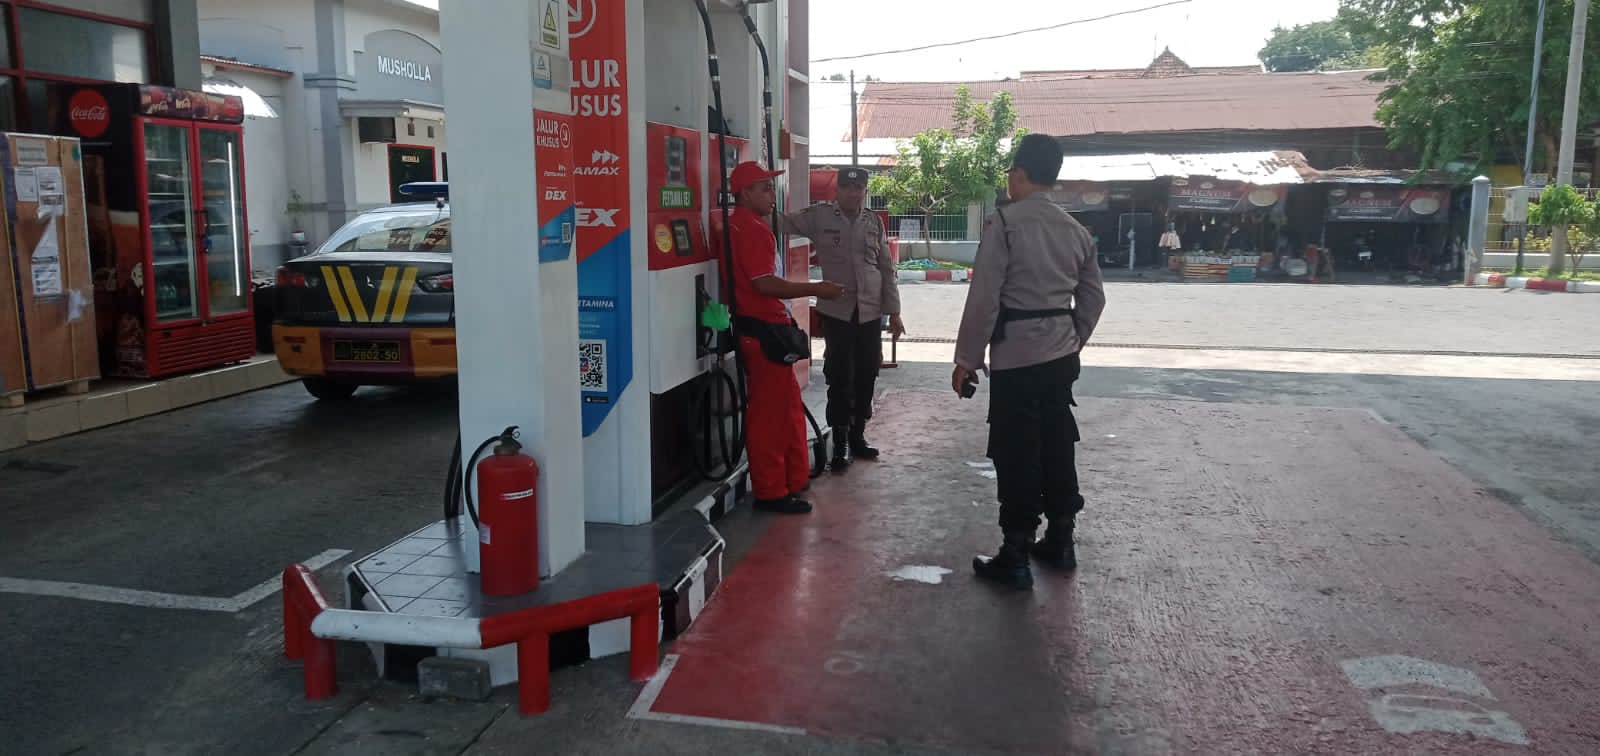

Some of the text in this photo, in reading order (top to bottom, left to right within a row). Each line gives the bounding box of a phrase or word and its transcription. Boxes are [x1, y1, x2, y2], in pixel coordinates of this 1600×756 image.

[377, 55, 432, 81] MUSHOLLA
[568, 58, 620, 88] LUR
[569, 94, 622, 117] USUS
[536, 118, 559, 136] JALUR
[573, 166, 620, 176] AMAX
[545, 190, 567, 201] DEX
[574, 207, 620, 227] EX
